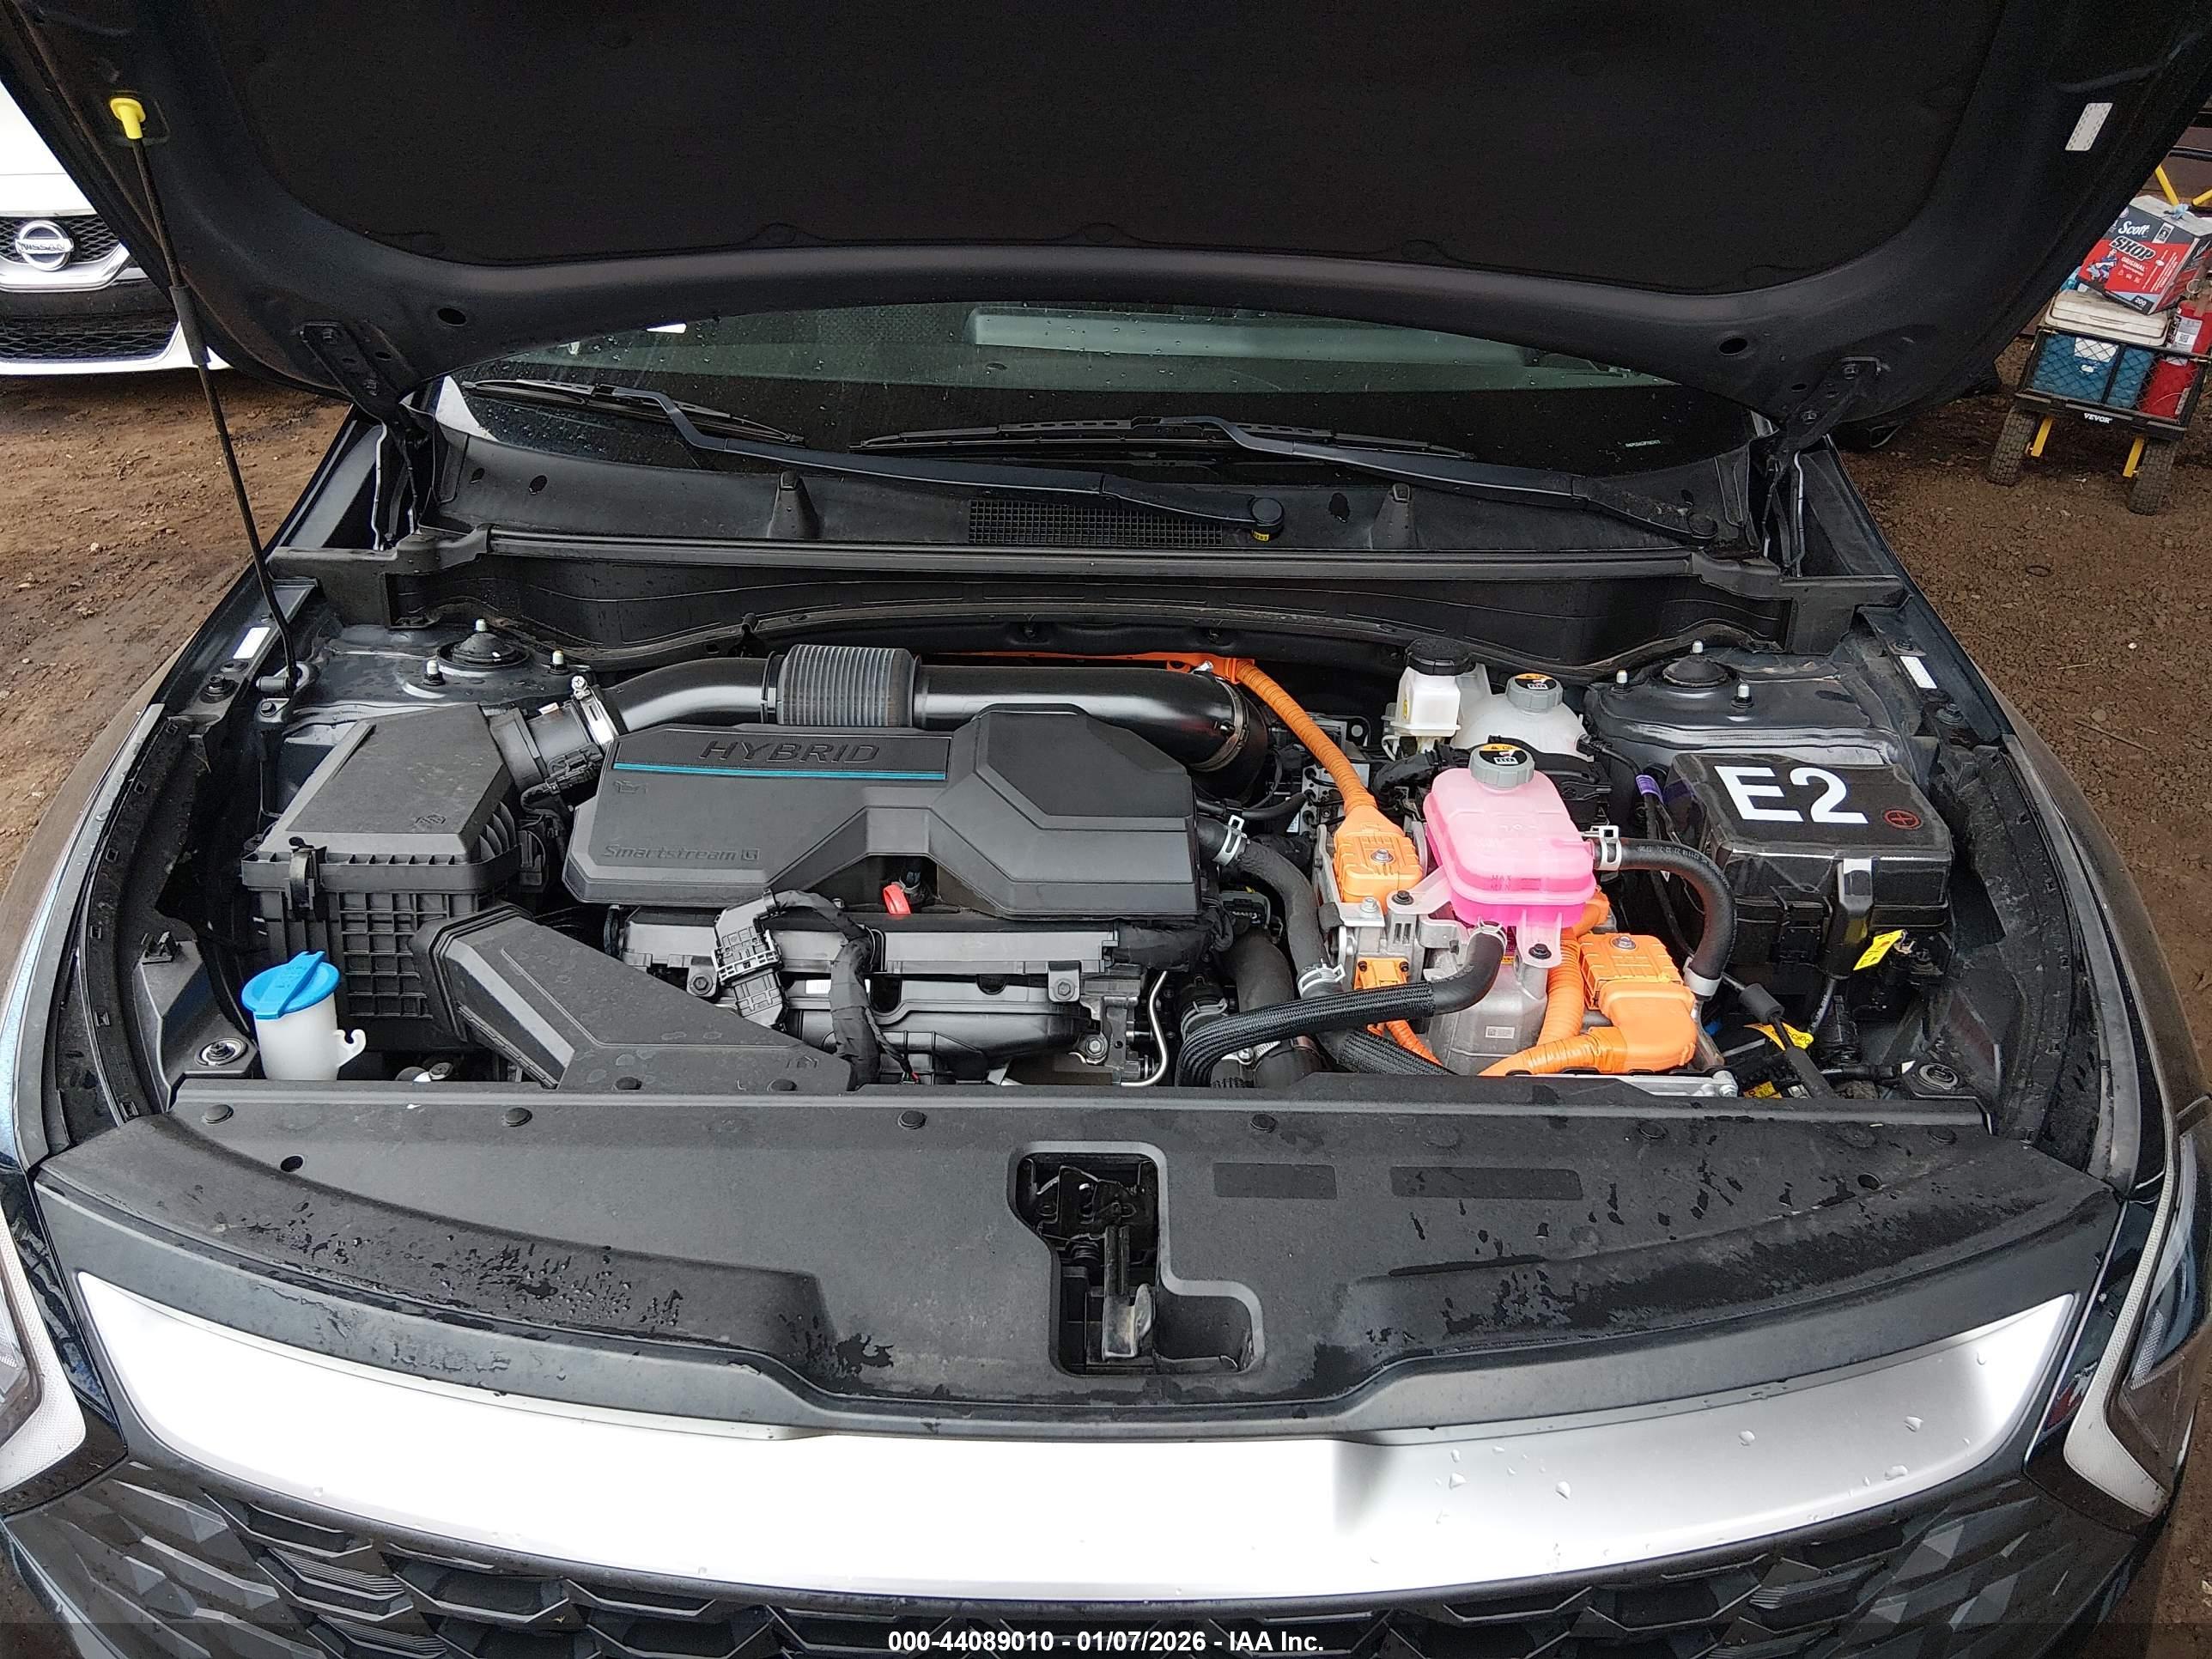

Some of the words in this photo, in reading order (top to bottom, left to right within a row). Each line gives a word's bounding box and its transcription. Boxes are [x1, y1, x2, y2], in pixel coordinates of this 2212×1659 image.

[2118, 221, 2150, 235] Scott
[2110, 236, 2155, 260] SHOP
[2121, 257, 2146, 270] ORIGINAL
[2135, 297, 2147, 306] 200
[2084, 413, 2111, 423] VEVOR
[699, 740, 880, 763] HYBRID
[1714, 765, 1869, 824] E2
[604, 846, 738, 861] Smartstream
